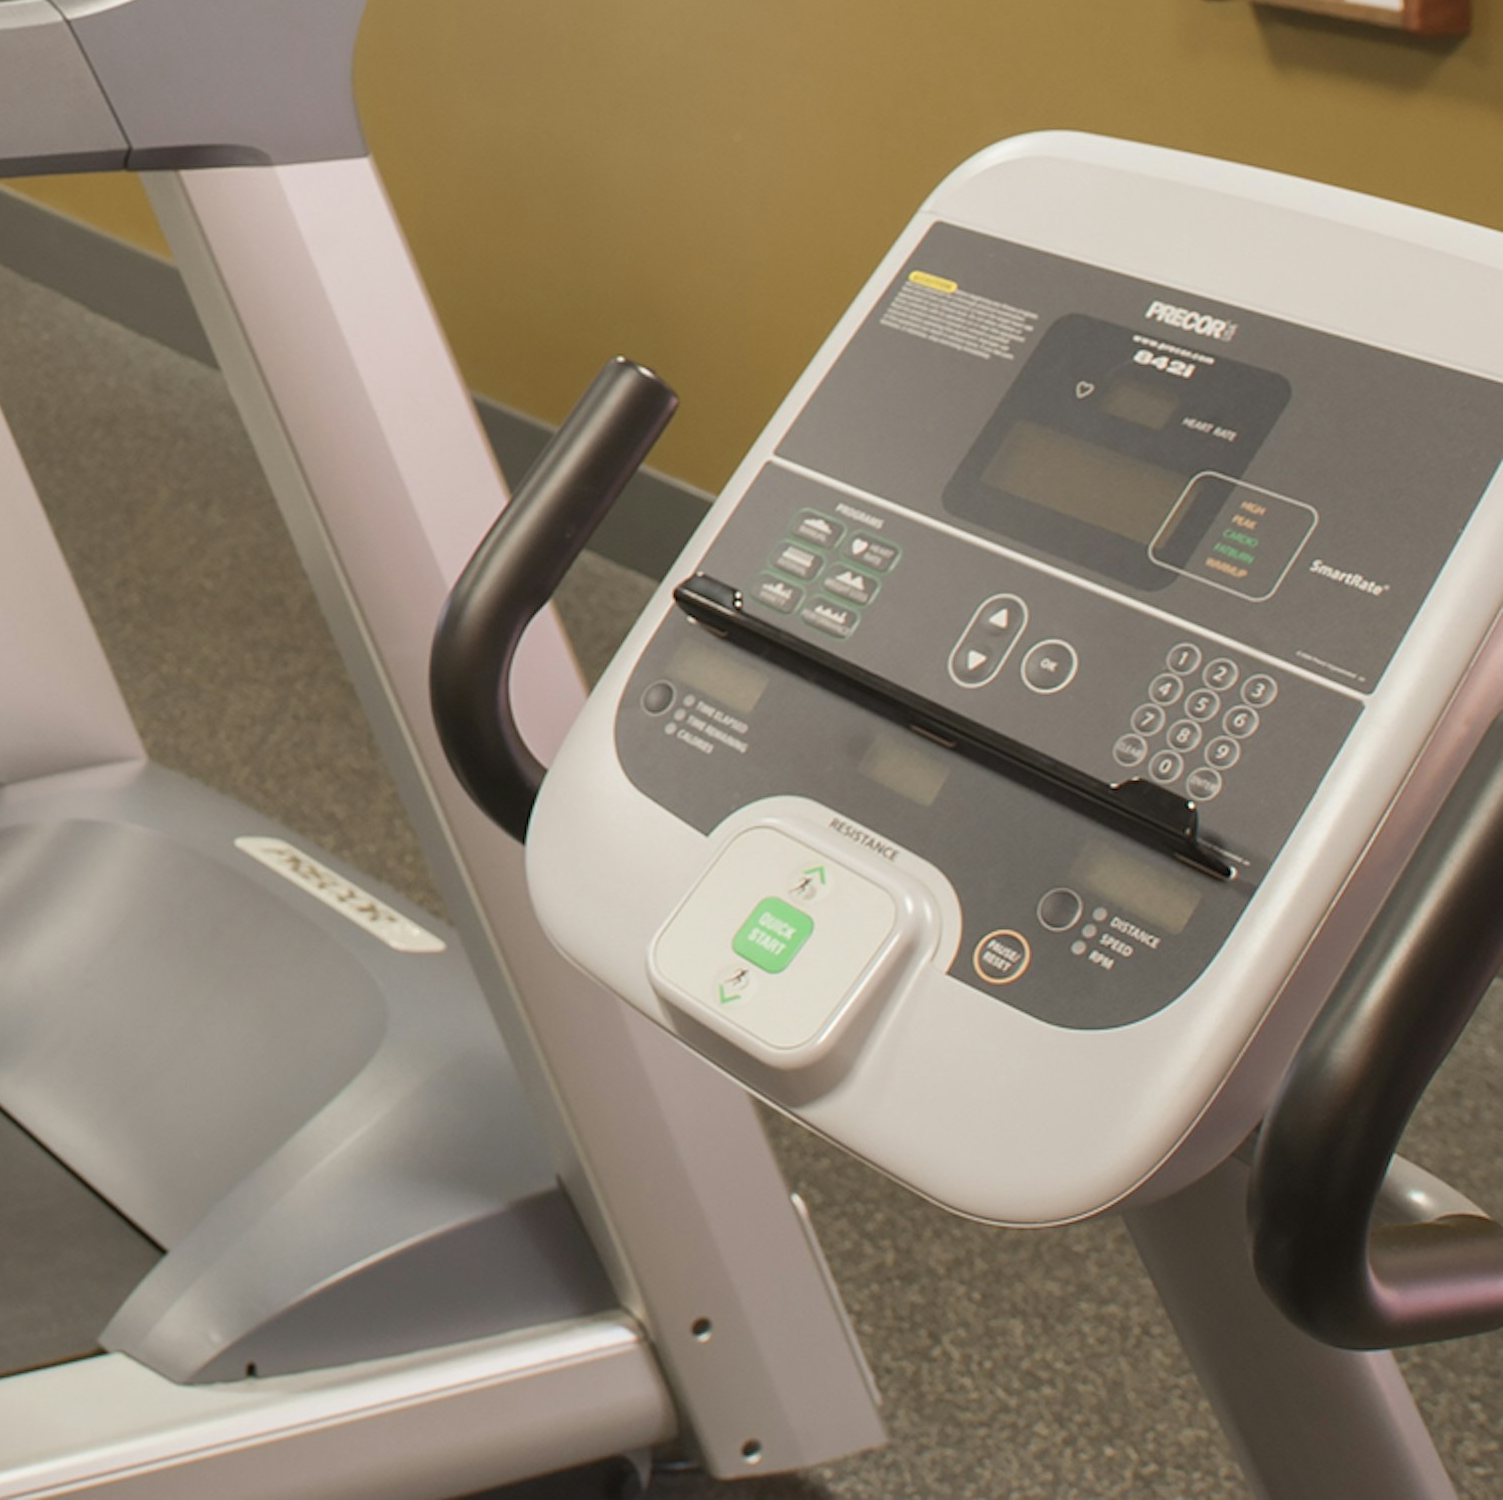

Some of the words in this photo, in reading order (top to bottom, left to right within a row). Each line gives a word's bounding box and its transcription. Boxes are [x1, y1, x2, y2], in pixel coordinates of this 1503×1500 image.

[1145, 300, 1226, 340] PRECOR
[1181, 415, 1213, 436] HEART
[1212, 425, 1238, 442] RATE
[1222, 528, 1259, 549] CARDIO
[1040, 657, 1059, 673] OK
[1178, 652, 1188, 666] 1
[1212, 666, 1227, 682] 2
[1157, 681, 1173, 697] 4
[1251, 683, 1266, 699] 3
[1194, 697, 1210, 712] 5
[1140, 713, 1156, 728] 7
[1233, 712, 1248, 728] 6
[1176, 727, 1191, 744] 8
[1215, 744, 1230, 760] 9
[1158, 759, 1173, 775] 0
[829, 818, 900, 862] RESISTANCE
[757, 911, 797, 942] QUICK
[1109, 916, 1161, 949] DISTANCE
[747, 927, 786, 956] START
[1099, 933, 1134, 958] SPEED
[982, 951, 1013, 972] RESET
[1088, 950, 1114, 970] RPM
